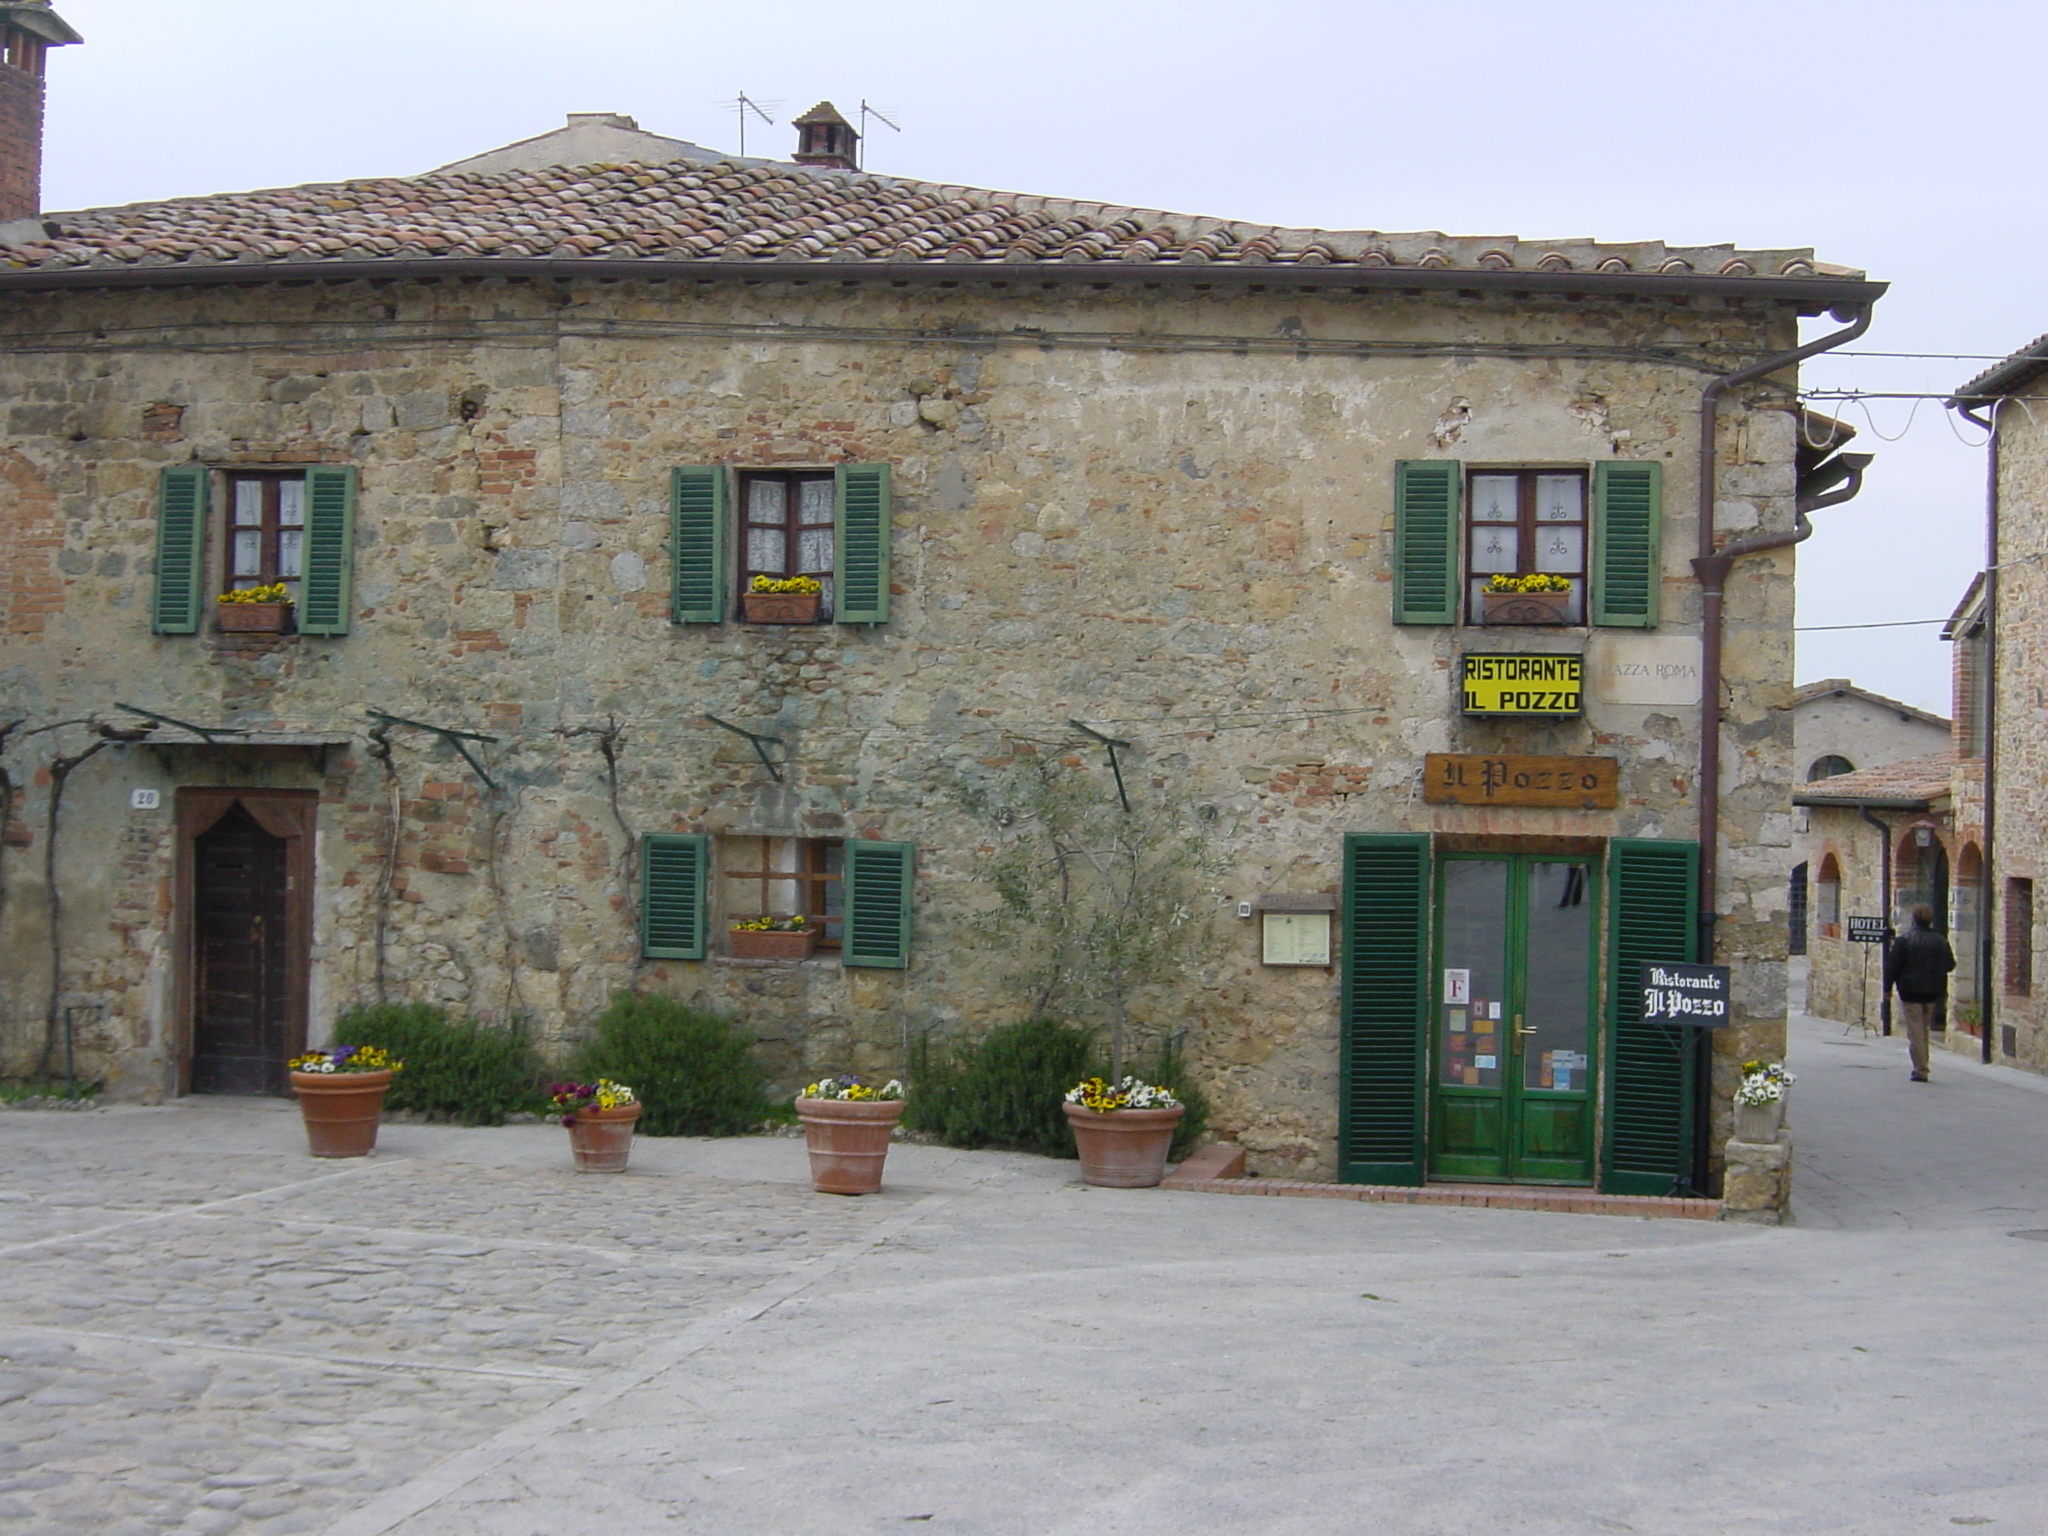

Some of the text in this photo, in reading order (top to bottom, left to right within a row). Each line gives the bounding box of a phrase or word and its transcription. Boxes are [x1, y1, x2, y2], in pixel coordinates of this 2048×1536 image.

[1465, 658, 1580, 680] RISTORANTE
[1656, 664, 1696, 678] ROMA
[1464, 691, 1580, 710] IL POZZO
[1442, 759, 1598, 797] Il Pozzo
[138, 792, 155, 805] 20
[1850, 917, 1887, 930] HOTEL
[1649, 967, 1721, 989] Ristorante
[1666, 989, 1725, 1018] Pozzo
